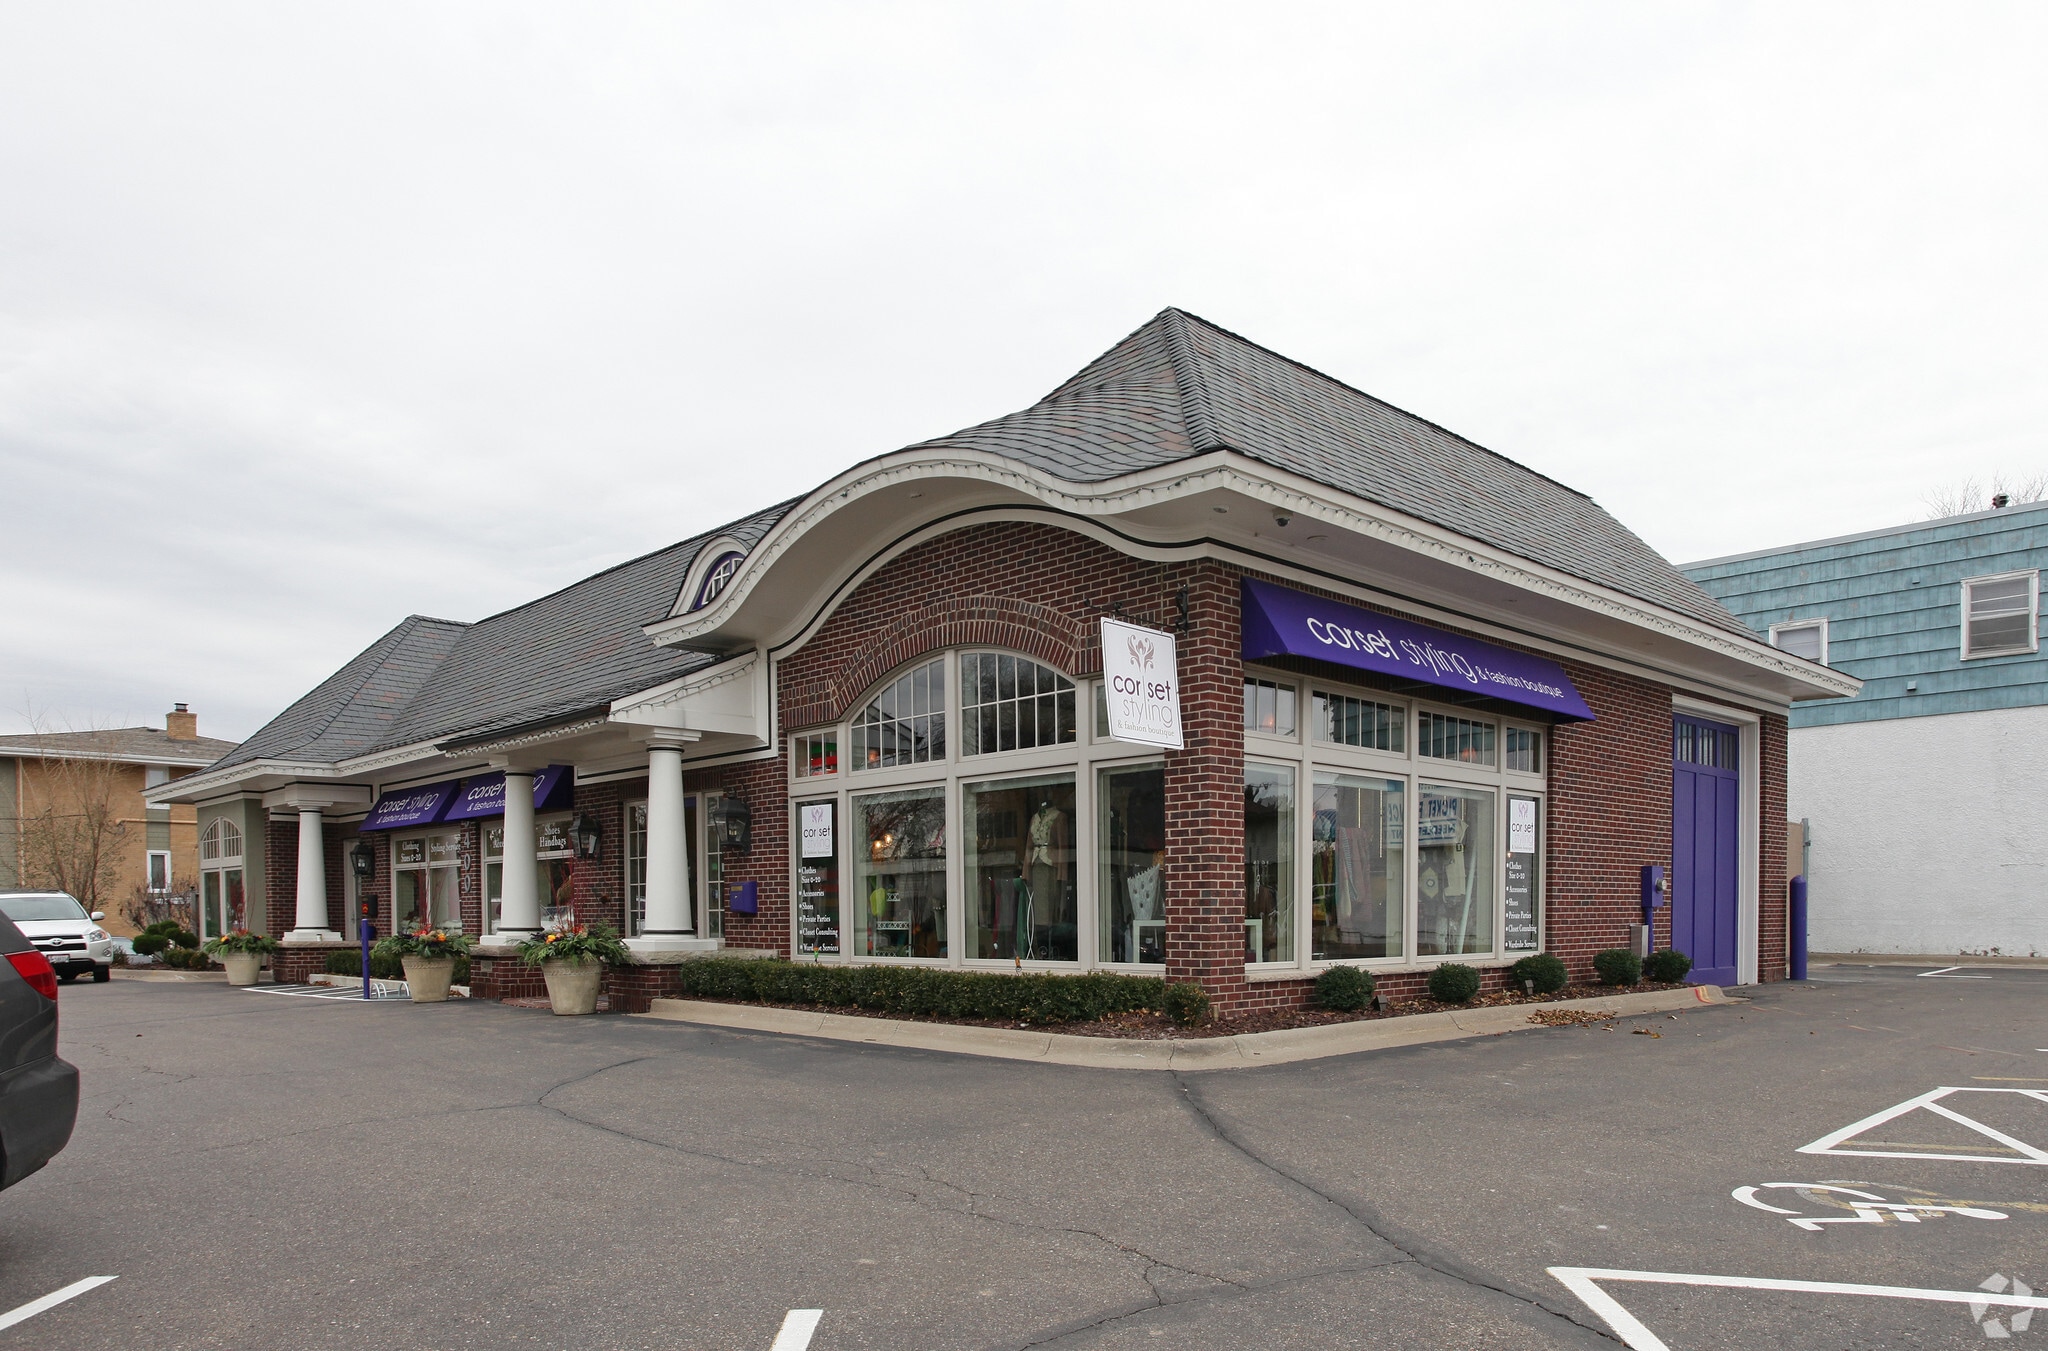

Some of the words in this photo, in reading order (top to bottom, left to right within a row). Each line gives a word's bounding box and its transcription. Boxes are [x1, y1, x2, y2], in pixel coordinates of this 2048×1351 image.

[1306, 617, 1400, 660] corset
[1399, 638, 1479, 685] styling
[1474, 665, 1488, 682] &
[1486, 670, 1524, 689] fashion
[1523, 676, 1564, 699] boutique
[1123, 697, 1173, 728] styling
[1124, 720, 1147, 733] fashion
[1147, 723, 1175, 739] boutique
[467, 782, 506, 801] corset
[378, 796, 410, 814] corset
[407, 791, 439, 812] styling
[544, 824, 560, 836] Shoes
[539, 835, 566, 849] Handbags
